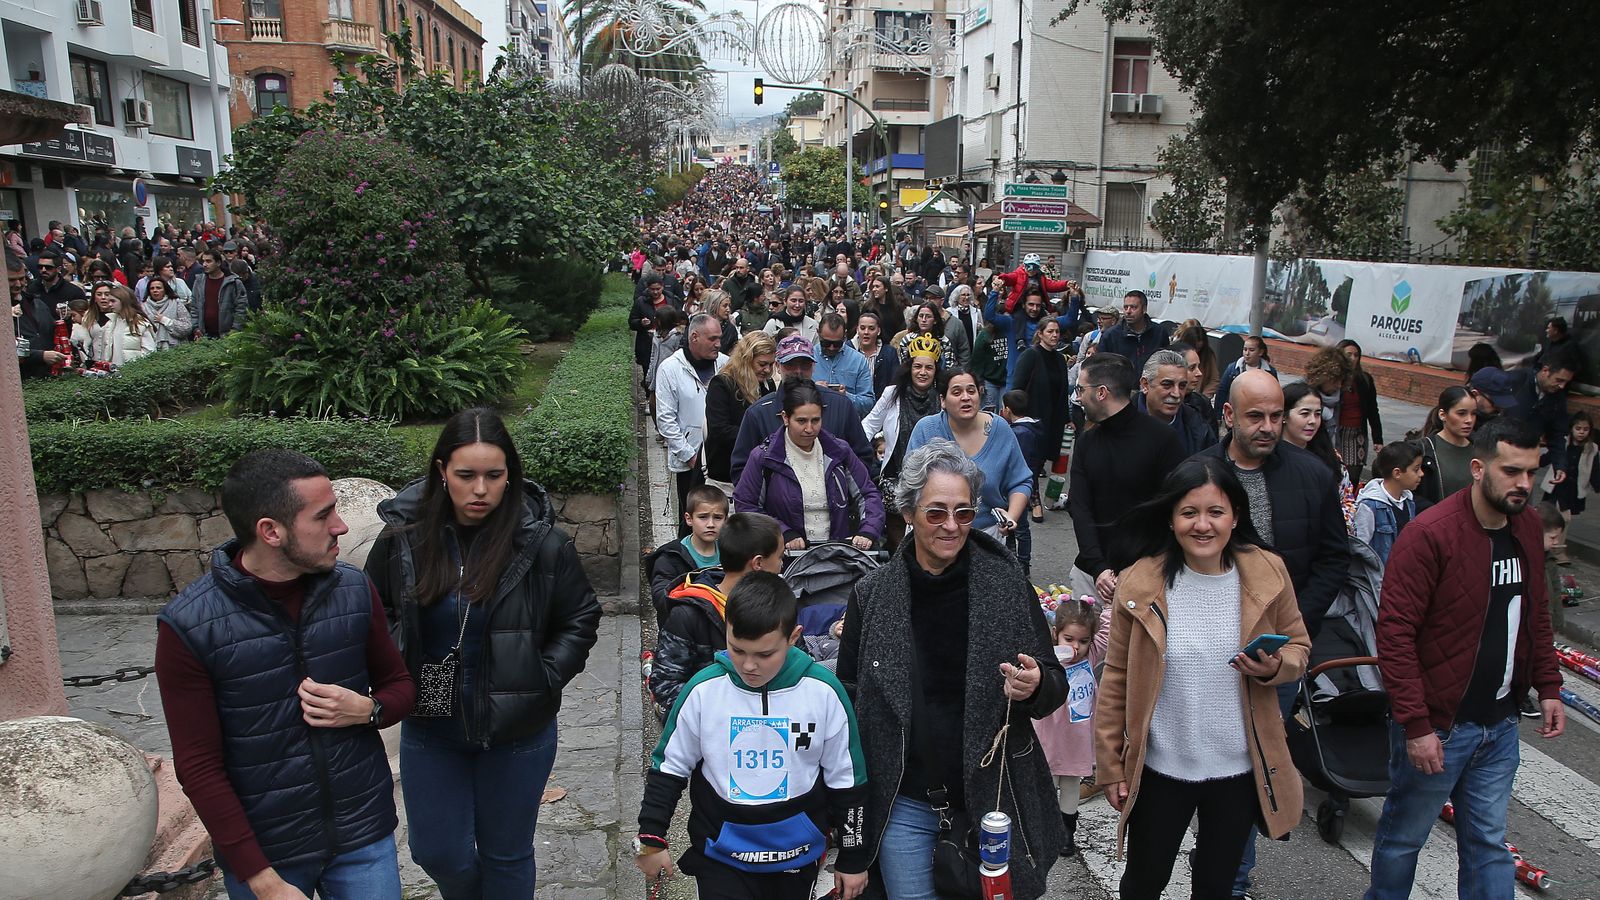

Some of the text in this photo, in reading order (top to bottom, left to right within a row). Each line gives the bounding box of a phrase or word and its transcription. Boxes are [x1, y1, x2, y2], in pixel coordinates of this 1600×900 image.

[1085, 284, 1100, 298] Parque
[1371, 315, 1423, 334] PARQUES
[1379, 332, 1409, 341] ALGECIRAS
[733, 749, 784, 769] 1315
[731, 843, 810, 863] MINECRAFT
